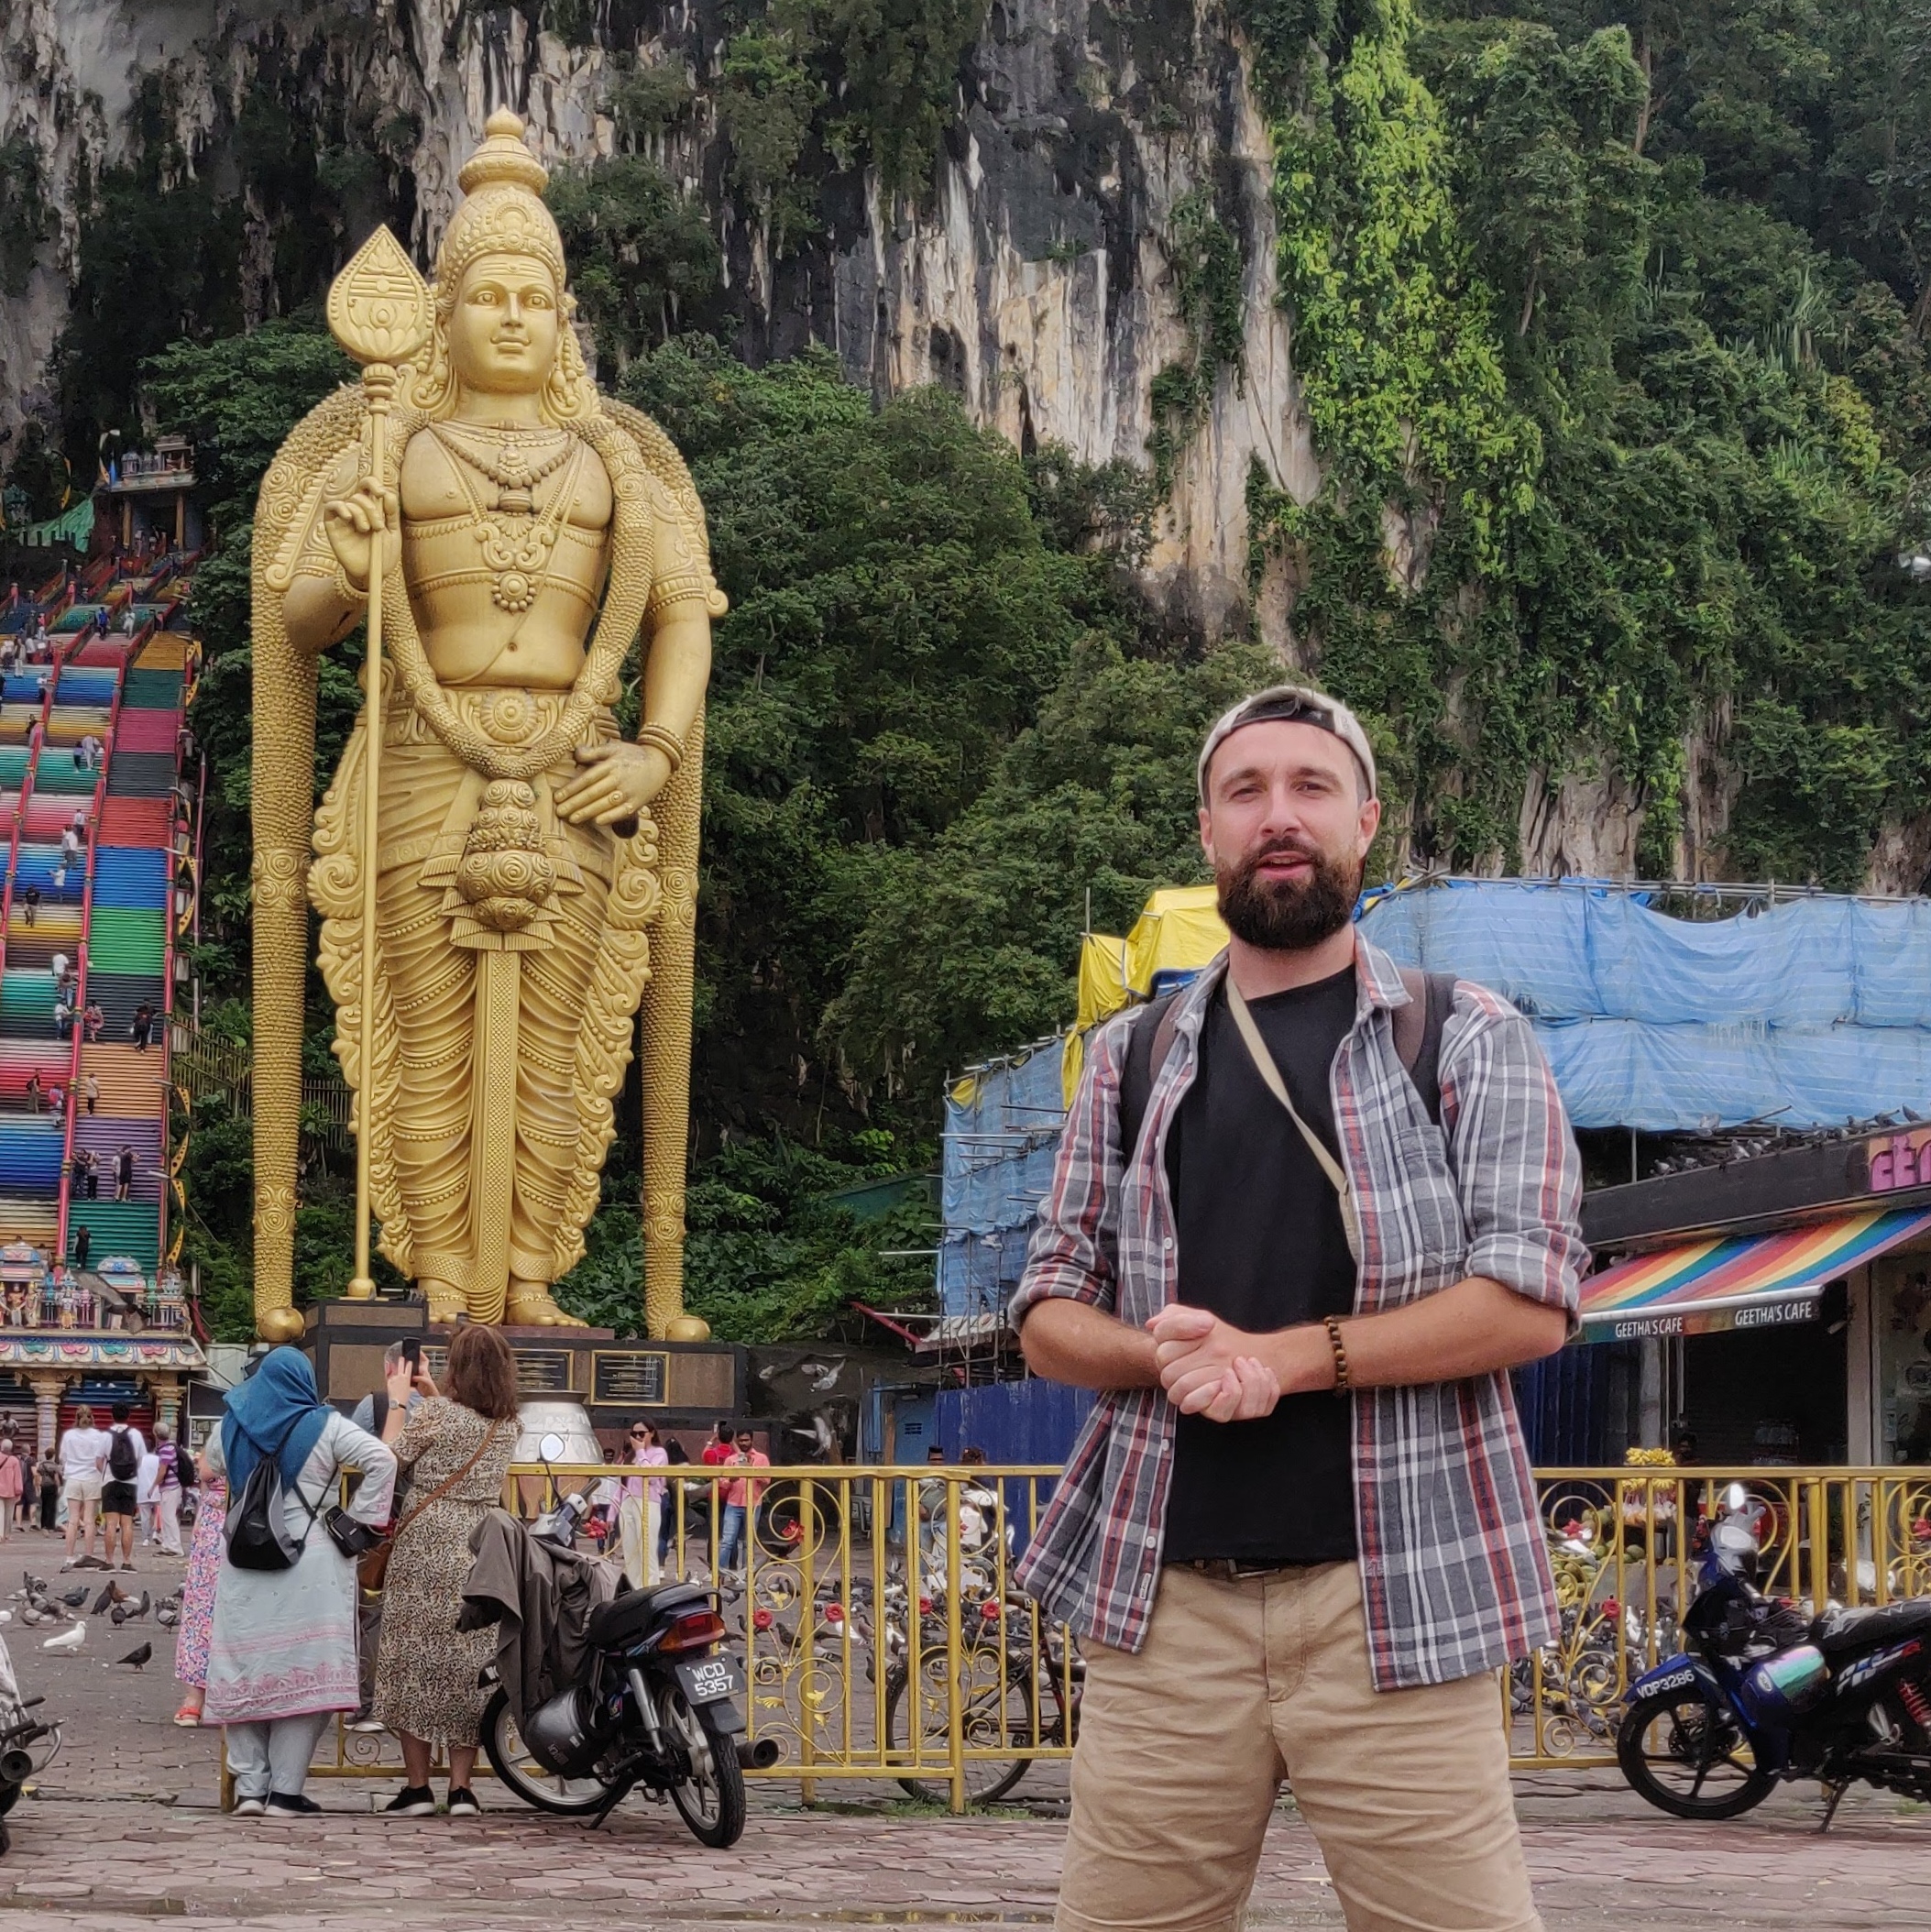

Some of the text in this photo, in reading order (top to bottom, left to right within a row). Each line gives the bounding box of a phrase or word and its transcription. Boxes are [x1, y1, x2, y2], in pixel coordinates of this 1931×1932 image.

[1735, 1301, 1812, 1325] GEETHA'S CAFE
[1616, 1317, 1683, 1337] GEETHA'S CAFE
[692, 1663, 725, 1681] WCD
[695, 1674, 733, 1696] 5357
